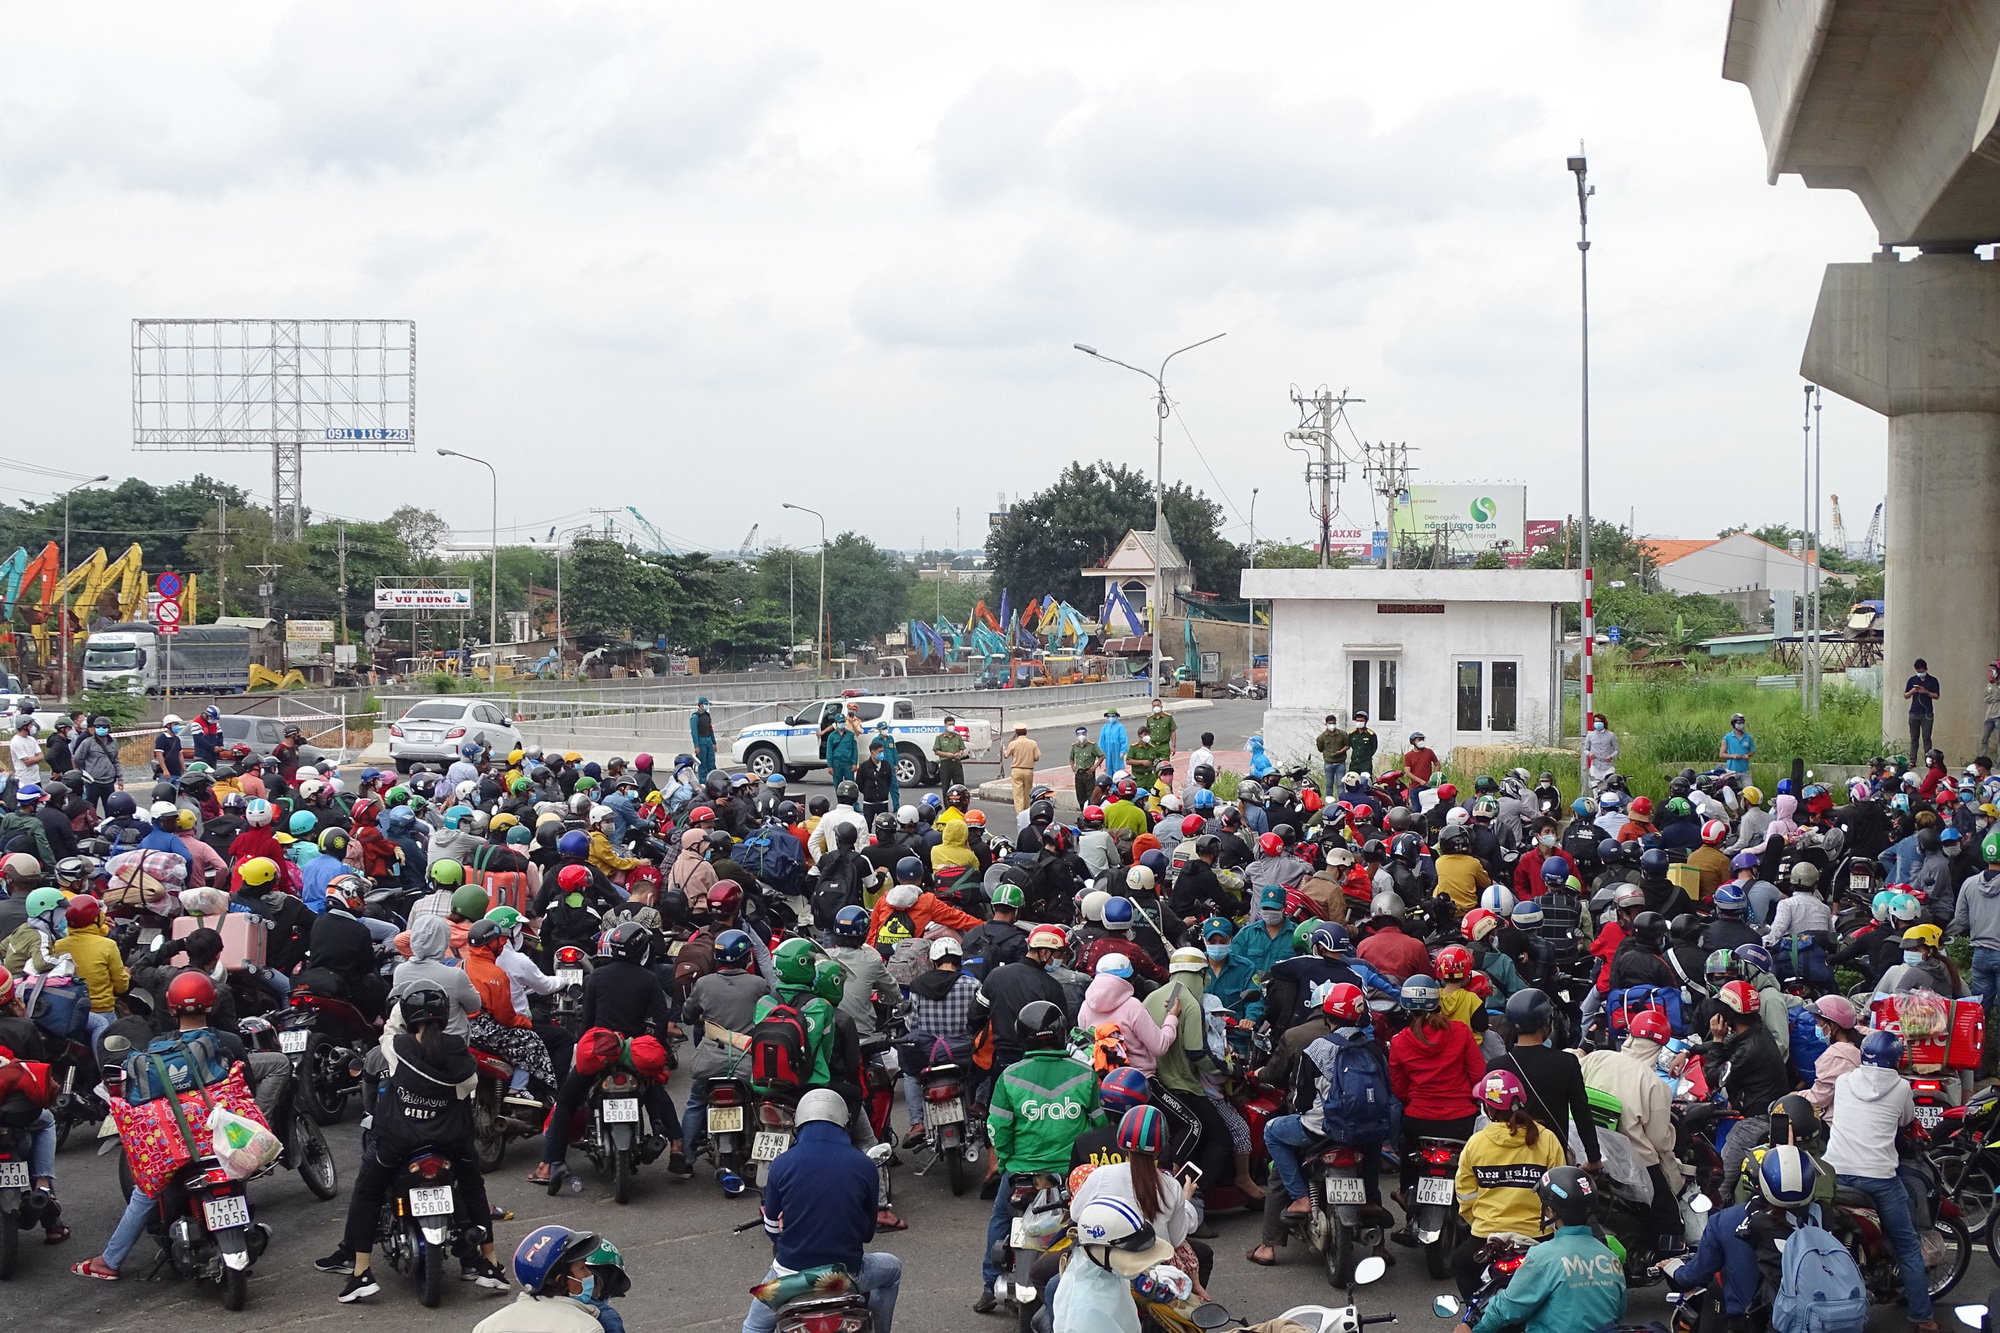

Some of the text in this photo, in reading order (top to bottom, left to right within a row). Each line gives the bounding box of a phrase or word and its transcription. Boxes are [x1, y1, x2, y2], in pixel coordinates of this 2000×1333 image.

[327, 428, 407, 439] 0911 116 228
[1475, 521, 1497, 531] sạch
[394, 595, 452, 604] VŨ HÙNG
[908, 725, 941, 734] THÔNG
[282, 1032, 303, 1042] 77-B1
[283, 1041, 305, 1052] 81.20
[608, 1100, 634, 1111] 59-X2
[1021, 1096, 1082, 1121] Grab
[404, 1106, 437, 1120] GIRLS
[606, 1110, 637, 1122] 550.88
[714, 1108, 738, 1120] 72-F1
[711, 1118, 741, 1131] 181.13
[1089, 1146, 1123, 1167] BẢO
[1331, 1178, 1359, 1191] 77-H1
[1423, 1178, 1449, 1192] 77-H1
[416, 1188, 446, 1202] 86-B2
[1329, 1190, 1364, 1203] 052.28
[1417, 1190, 1452, 1204] 406.49
[210, 1198, 240, 1216] 74-F1
[414, 1201, 451, 1216] 556.08
[209, 1210, 248, 1230] 328.56
